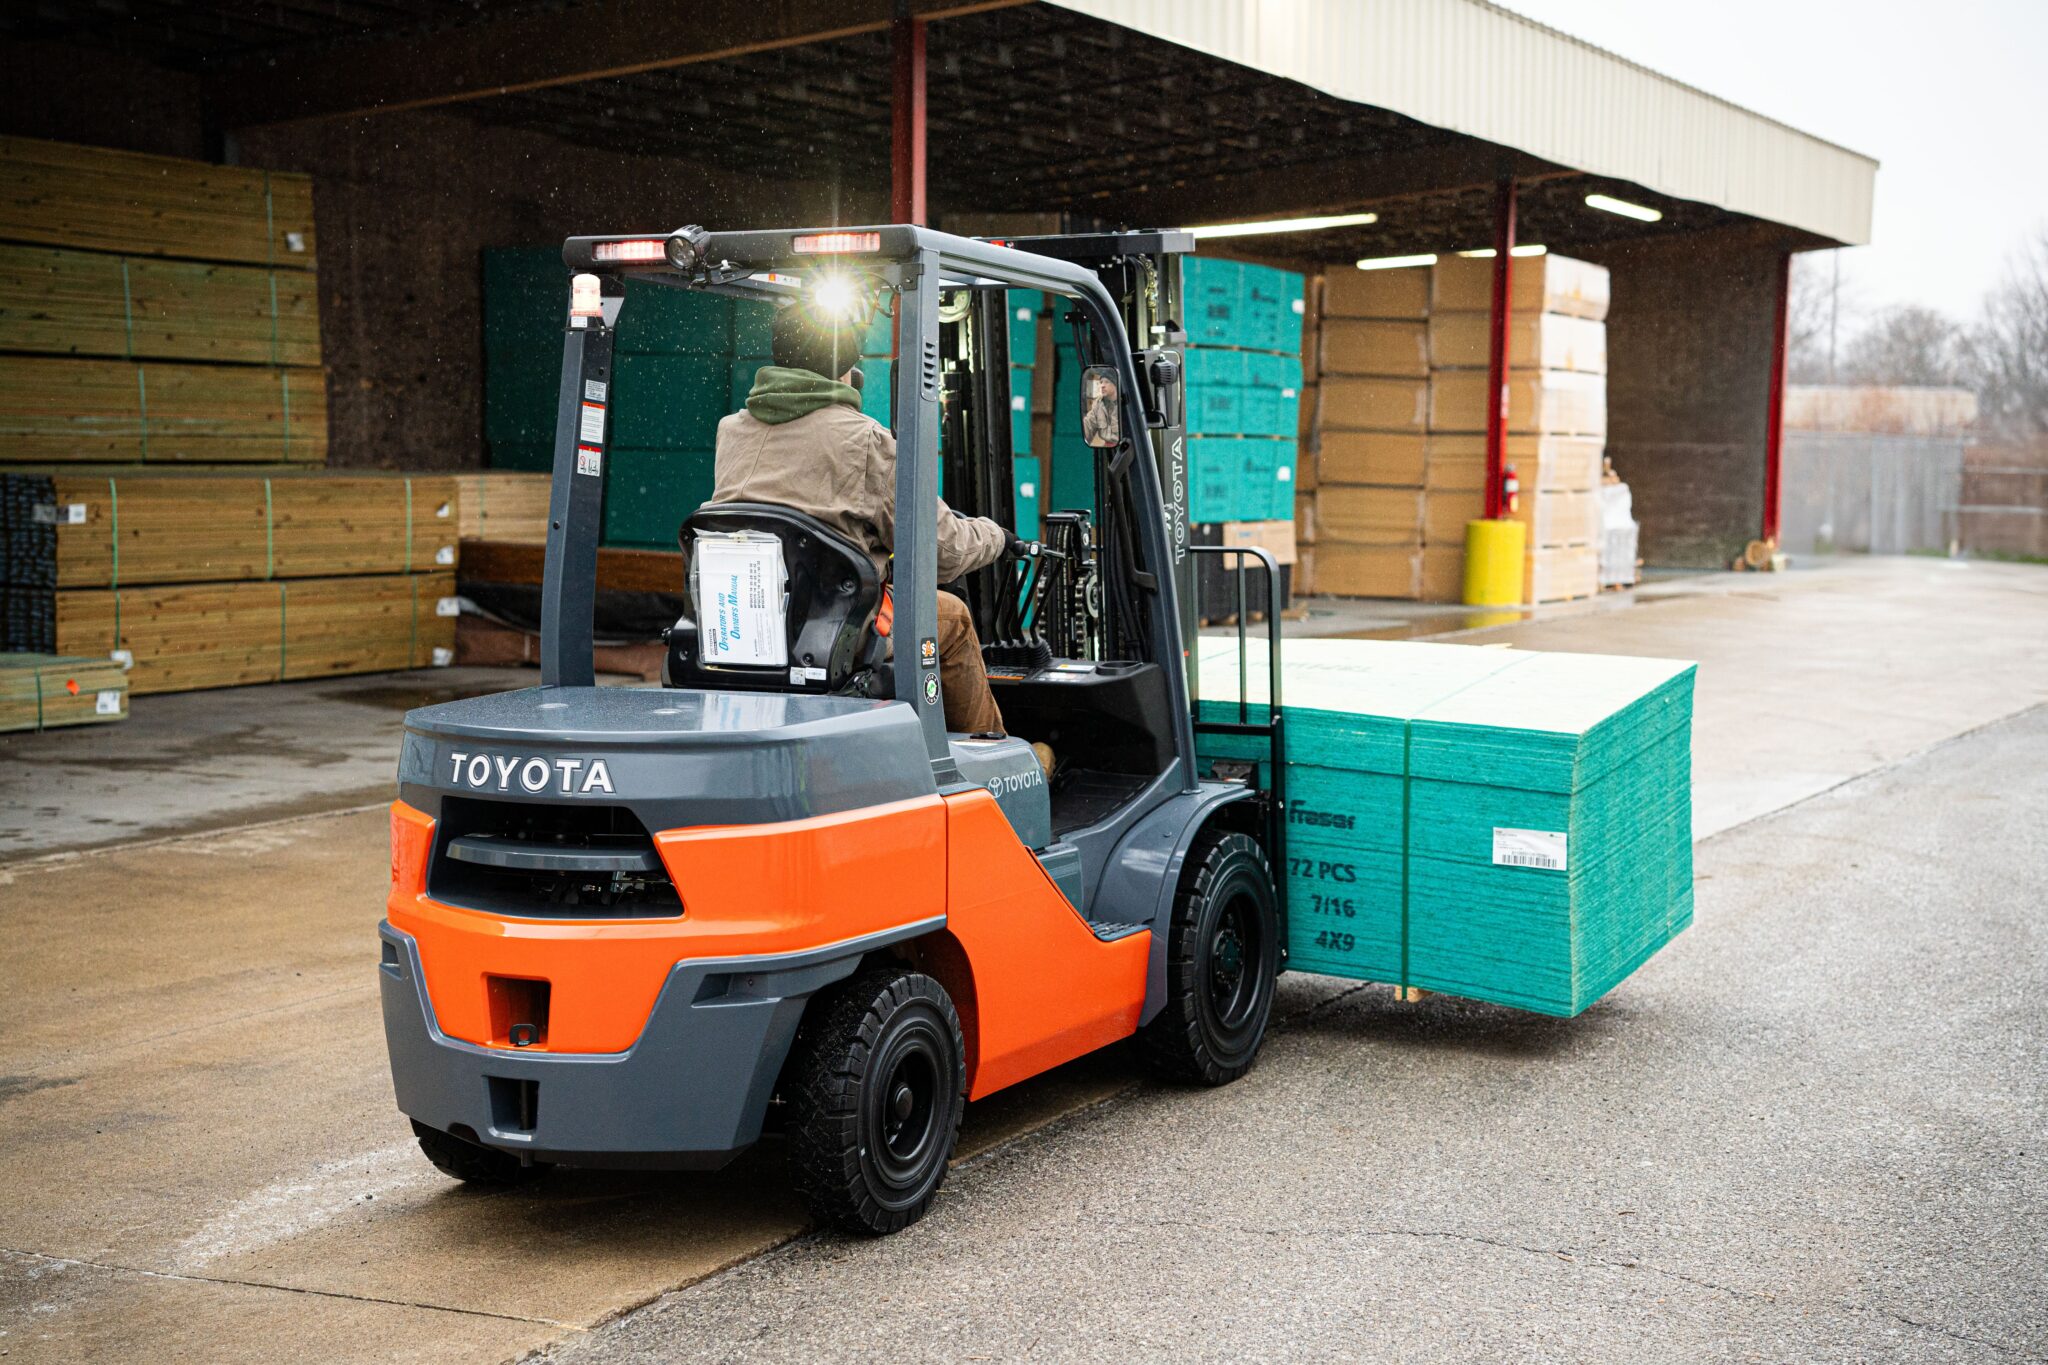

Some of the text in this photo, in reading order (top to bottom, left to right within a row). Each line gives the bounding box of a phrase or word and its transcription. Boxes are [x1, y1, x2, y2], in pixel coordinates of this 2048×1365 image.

[1171, 437, 1185, 564] TOYOTA
[922, 641, 935, 656] SAS
[451, 753, 616, 793] TOYOTA
[1004, 770, 1042, 793] TOYOTA
[1289, 857, 1356, 883] 72 PCS
[1310, 894, 1356, 918] 7/16
[1314, 930, 1356, 952] 4X9
